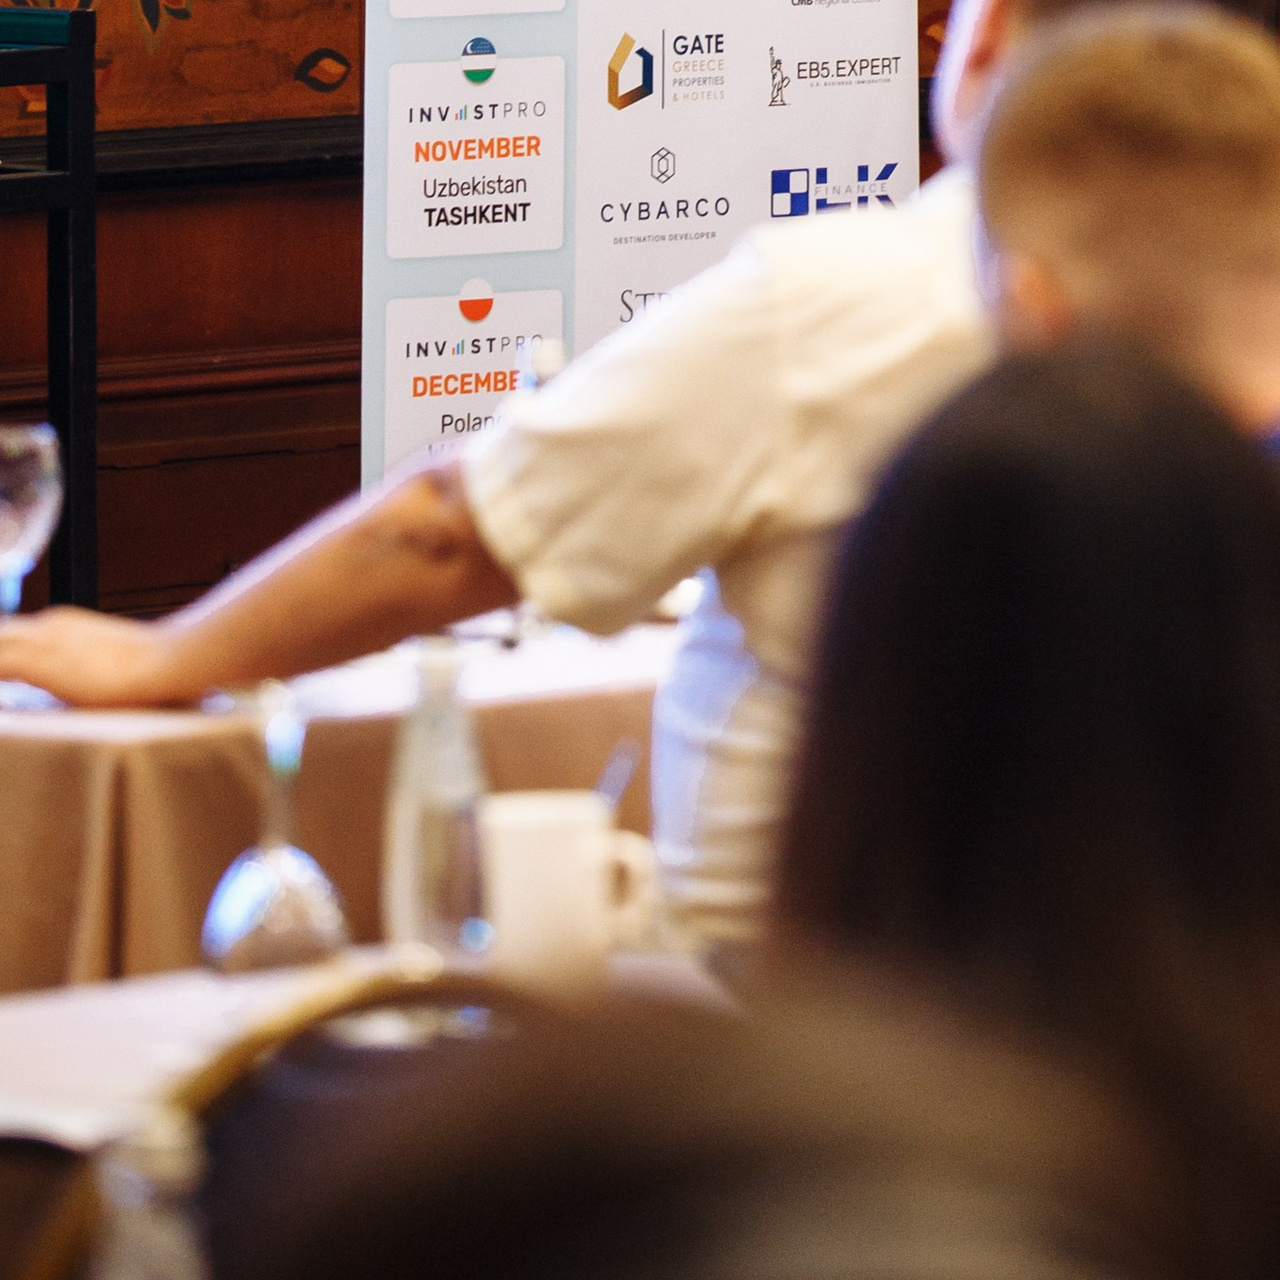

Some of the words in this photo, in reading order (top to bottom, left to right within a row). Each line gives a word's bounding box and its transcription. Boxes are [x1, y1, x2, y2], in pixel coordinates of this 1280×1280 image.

[673, 34, 723, 55] GATE
[672, 59, 725, 73] GREECE
[797, 57, 901, 79] EB5.EXPERT
[672, 76, 725, 87] PROPERTIES
[415, 136, 540, 162] NOVEMBER
[424, 175, 526, 198] Uzbekistan
[424, 203, 530, 227] TASHKENT
[601, 197, 729, 222] CYBARCO
[614, 235, 665, 244] DESTINATION
[669, 232, 716, 241] DEVELOPER
[412, 370, 520, 397] DECEMBE
[441, 412, 502, 434] Polan
